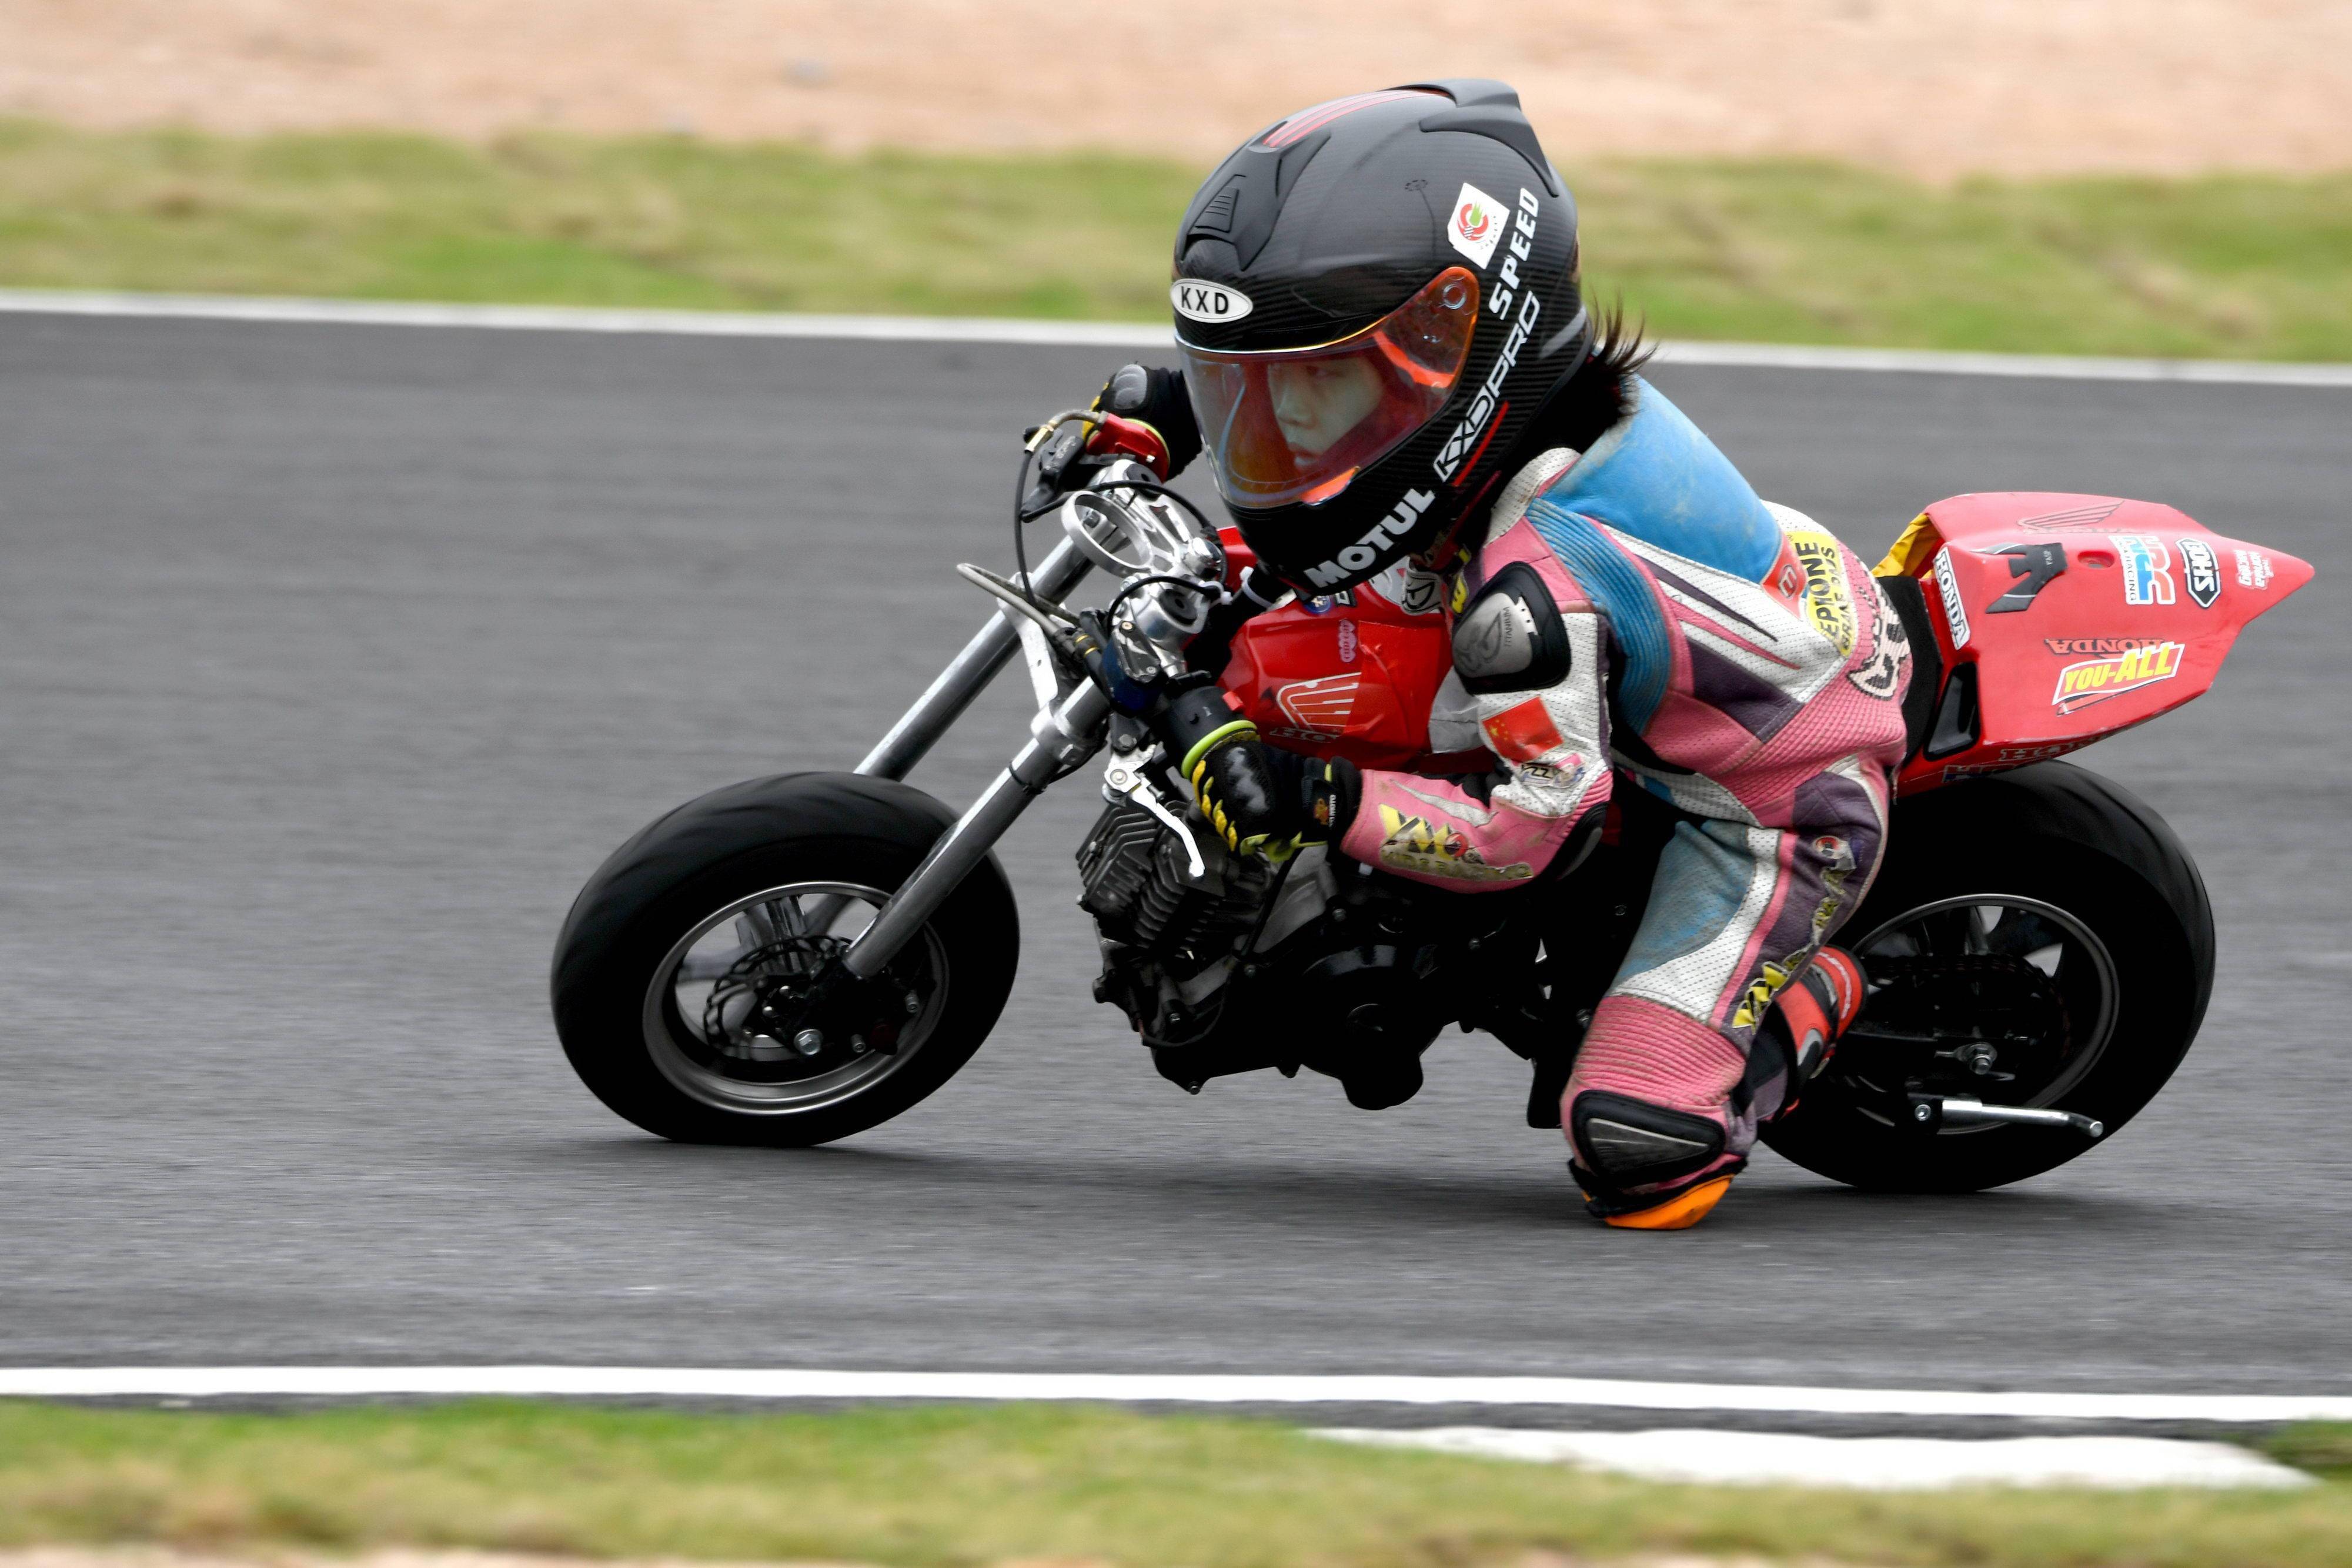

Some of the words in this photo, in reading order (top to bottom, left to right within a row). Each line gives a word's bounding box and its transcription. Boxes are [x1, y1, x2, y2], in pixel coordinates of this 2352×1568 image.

[1488, 188, 1539, 320] SPEED
[1181, 286, 1229, 315] KXD
[1303, 488, 1436, 588] MOTUL
[2181, 541, 2216, 593] SHOEI
[1935, 550, 1967, 647] HONDA
[2064, 646, 2173, 693] YOU-ALL
